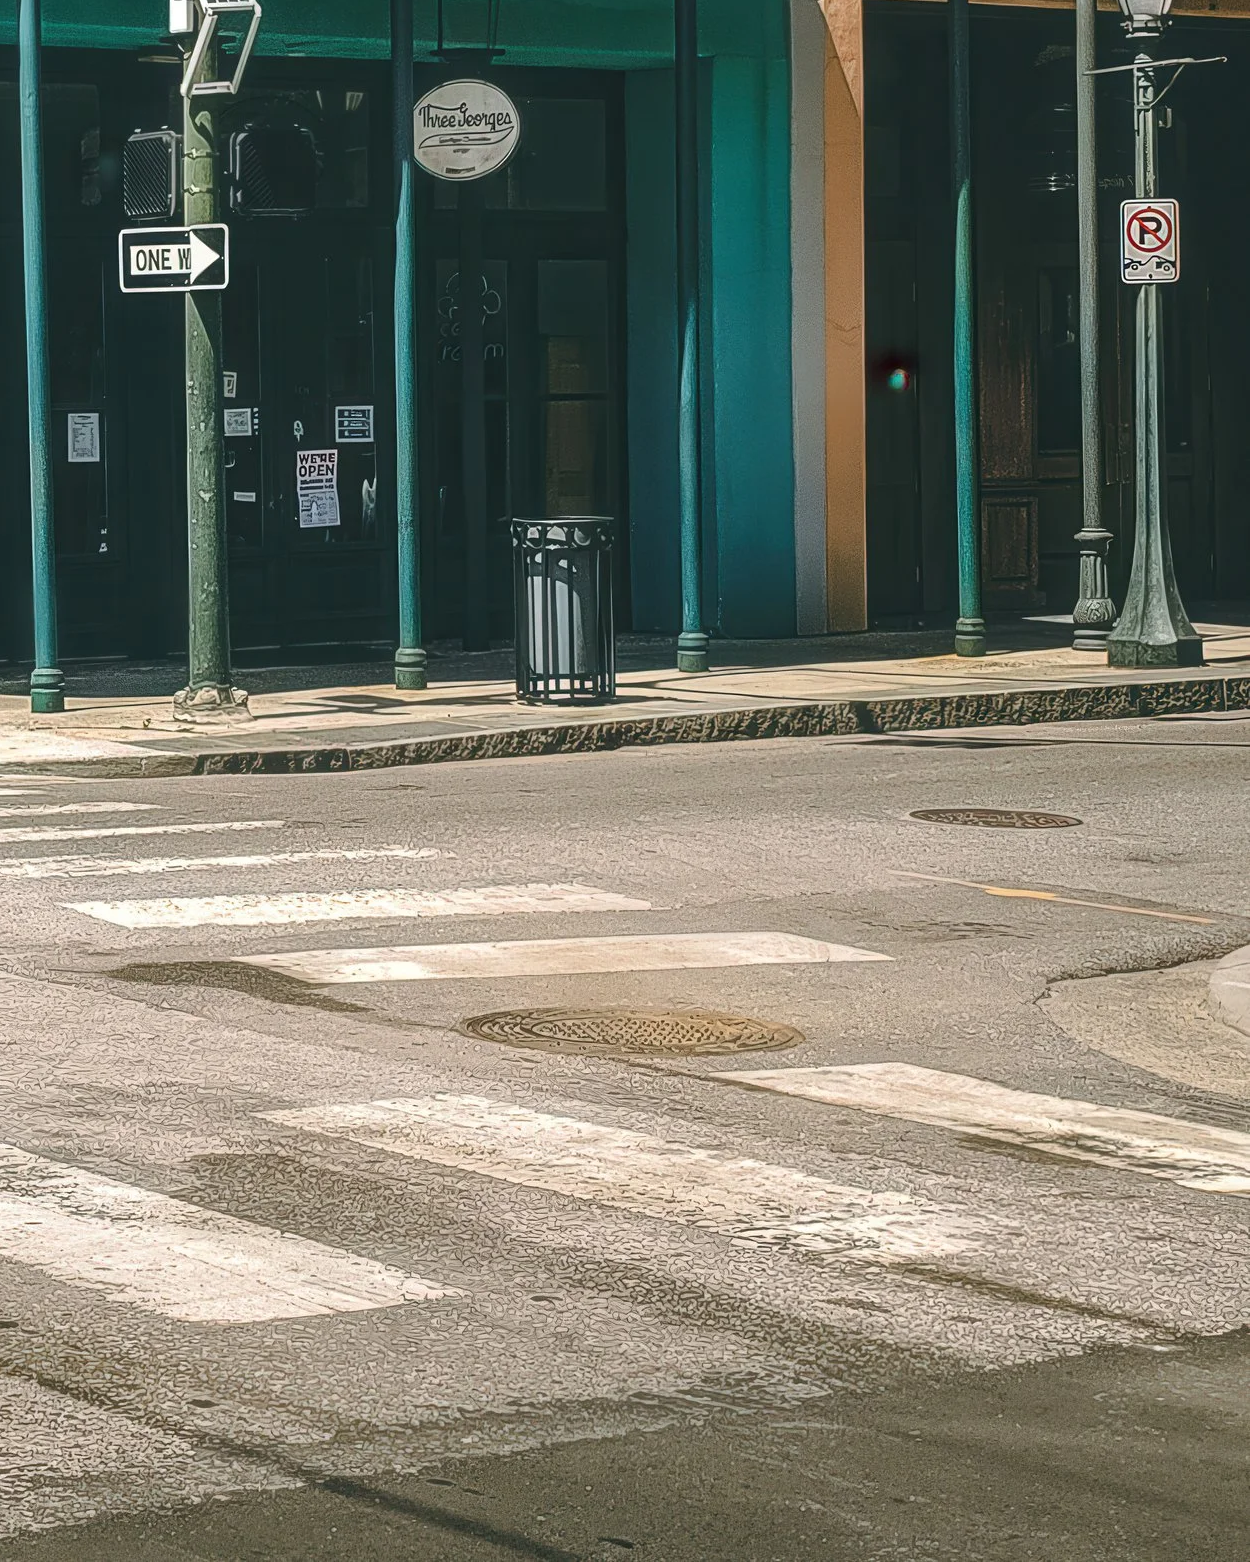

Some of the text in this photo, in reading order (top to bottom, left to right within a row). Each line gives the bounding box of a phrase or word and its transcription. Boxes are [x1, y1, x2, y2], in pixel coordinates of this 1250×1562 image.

[418, 104, 459, 128] Three
[136, 249, 172, 271] ONE
[299, 464, 335, 477] OPEN
